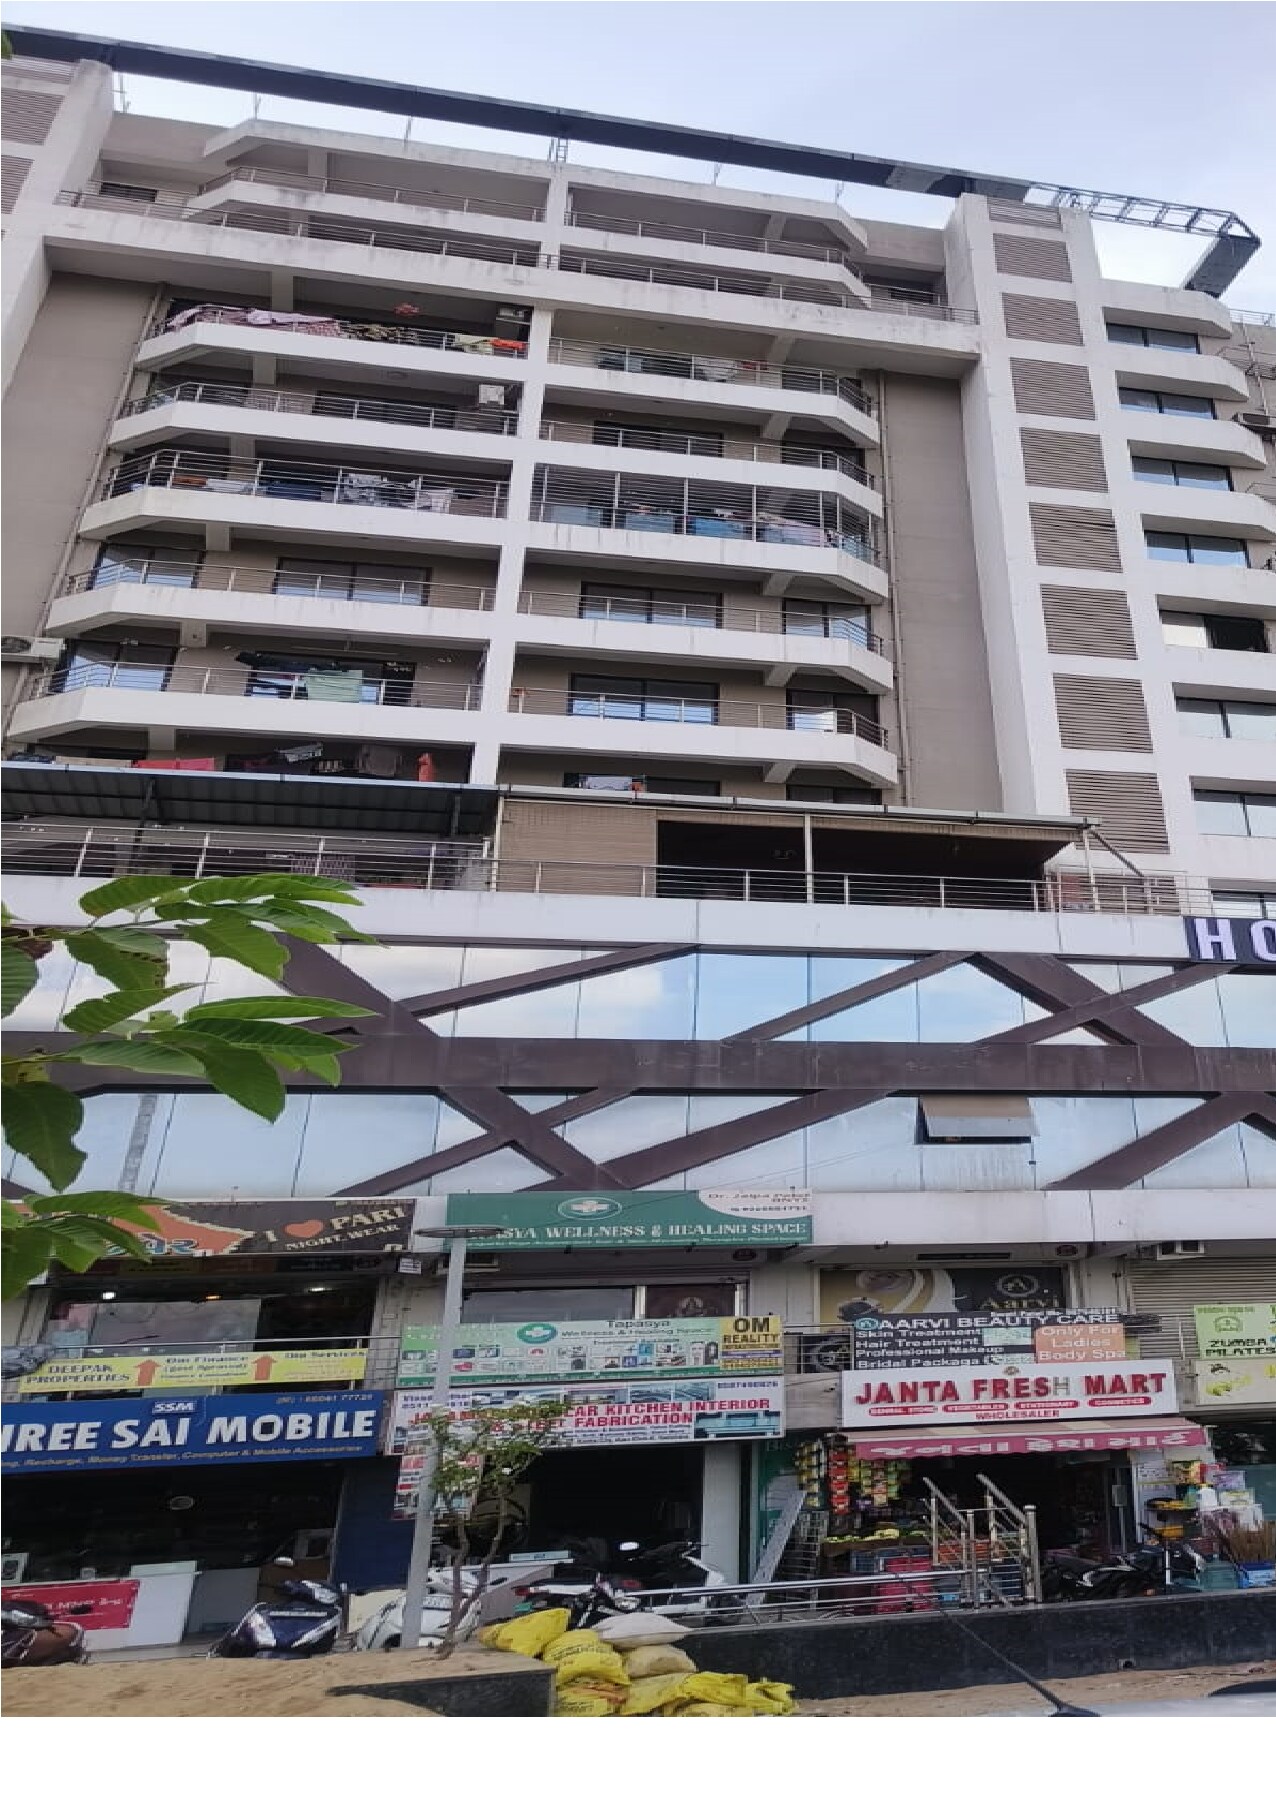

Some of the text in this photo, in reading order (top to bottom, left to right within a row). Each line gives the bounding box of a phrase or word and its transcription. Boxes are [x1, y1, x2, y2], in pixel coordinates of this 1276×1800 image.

[330, 1207, 404, 1230] PARI
[546, 1225, 645, 1238] WELLNESS
[669, 1224, 747, 1235] HEALING
[751, 1223, 806, 1234] SPACE
[607, 1320, 670, 1329] Tapasya
[733, 1317, 771, 1333] OM
[880, 1317, 950, 1330] AARVI
[957, 1314, 1047, 1328] BEAUTY
[1056, 1312, 1119, 1324] CARE
[723, 1333, 779, 1344] REALITY
[1041, 1326, 1083, 1337] Only
[1052, 1337, 1111, 1347] Ladies
[1039, 1350, 1085, 1361] Body
[854, 1373, 1167, 1405] JANTA FRESH MART
[153, 1401, 196, 1412] SSM
[606, 1402, 683, 1415] KITCHEN
[689, 1399, 771, 1411] INTERIOR
[574, 1413, 693, 1427] FABRICATION
[975, 1410, 1060, 1420] WHOLESALER
[110, 1418, 191, 1449] SAI
[206, 1410, 377, 1444] MOBILE
